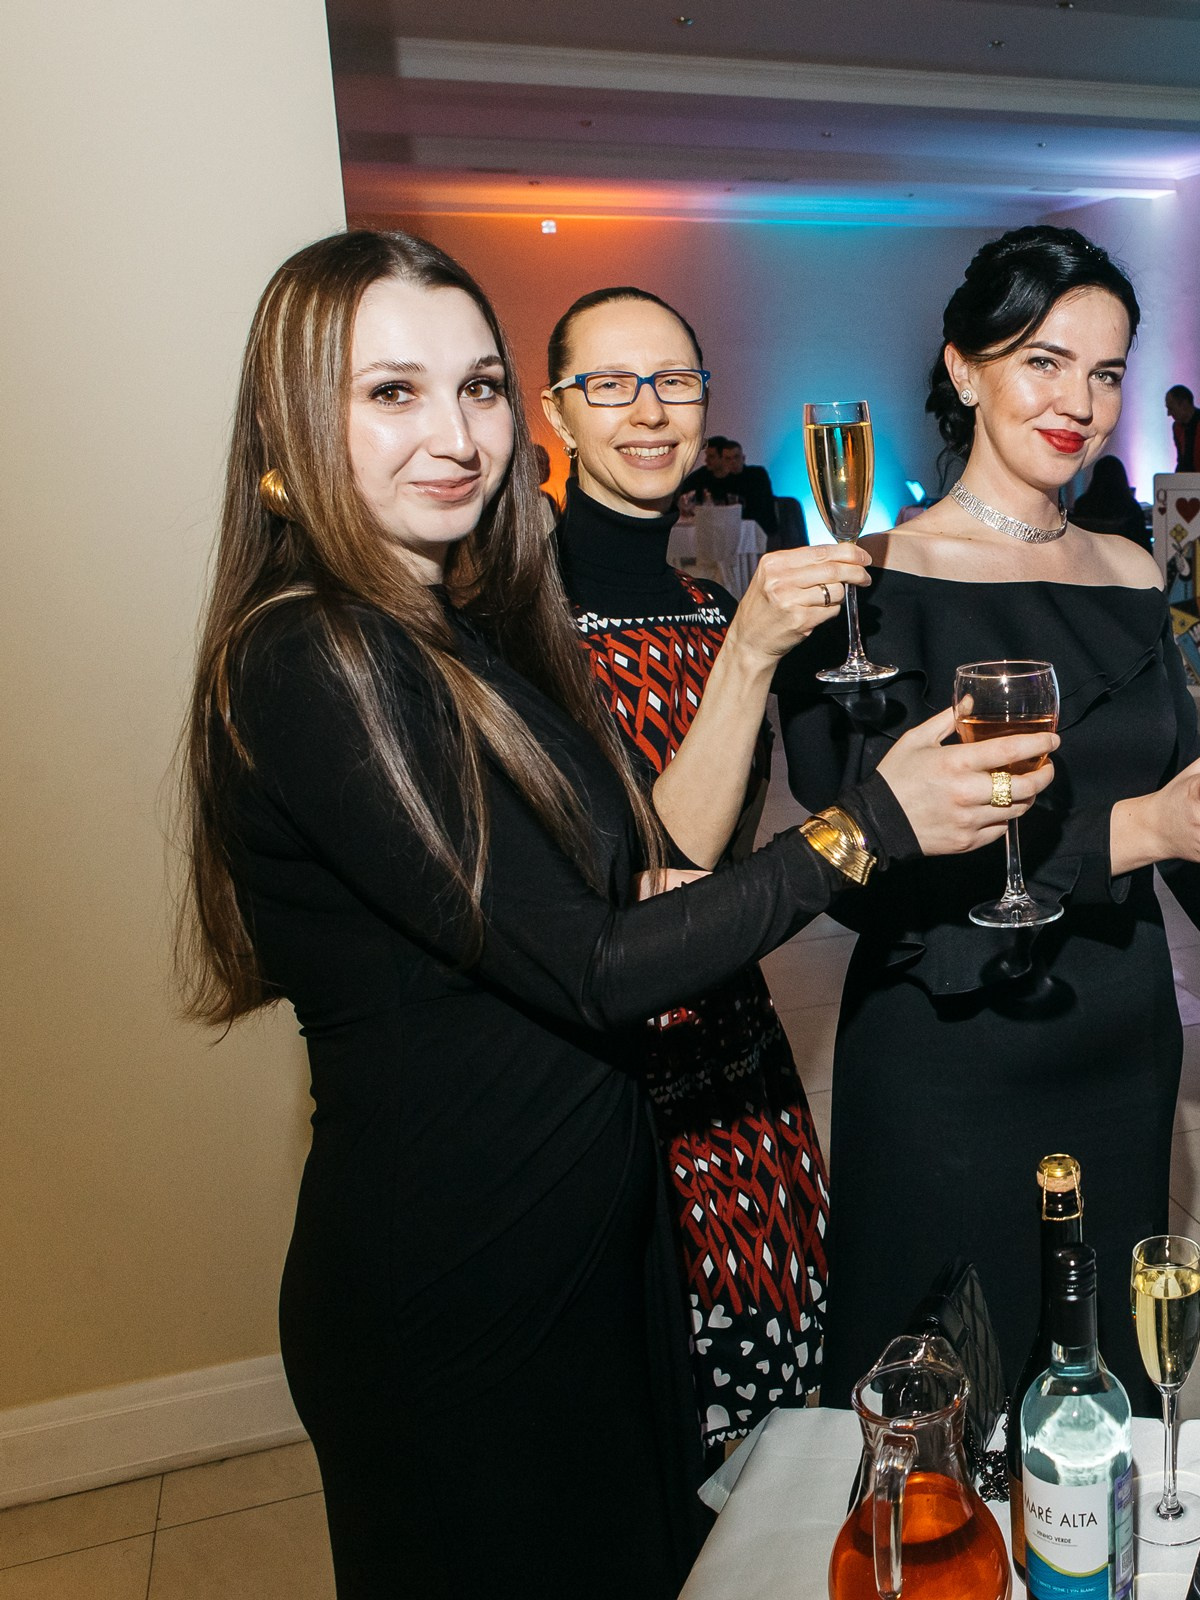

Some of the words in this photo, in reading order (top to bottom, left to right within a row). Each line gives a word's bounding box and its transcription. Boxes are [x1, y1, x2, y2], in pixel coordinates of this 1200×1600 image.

[1156, 489, 1167, 505] Q
[1025, 1493, 1052, 1525] MARÉ
[1060, 1512, 1098, 1528] ALTA
